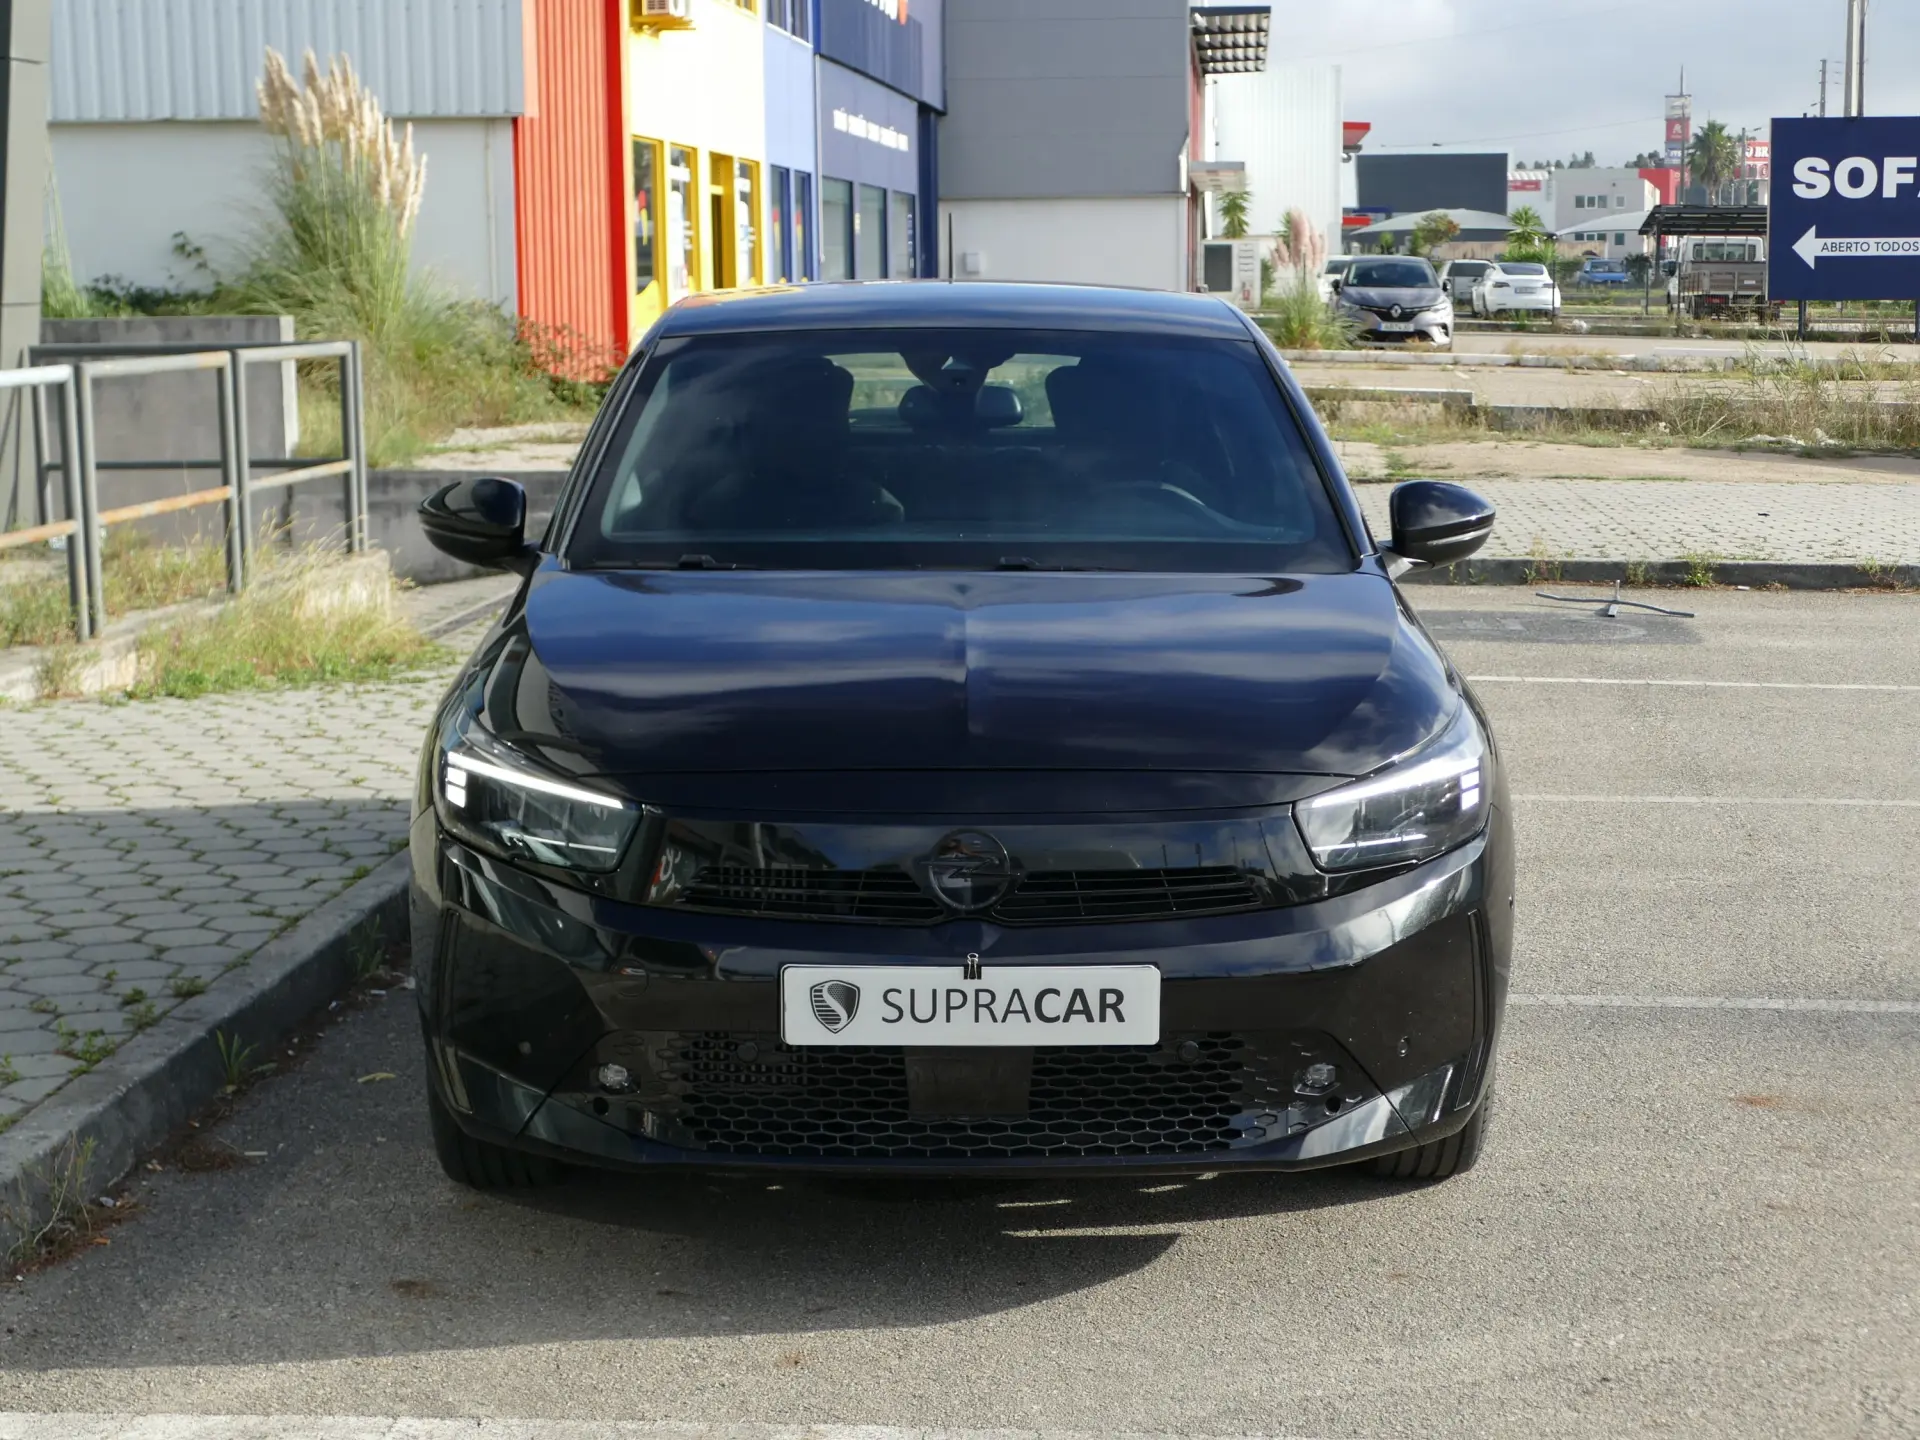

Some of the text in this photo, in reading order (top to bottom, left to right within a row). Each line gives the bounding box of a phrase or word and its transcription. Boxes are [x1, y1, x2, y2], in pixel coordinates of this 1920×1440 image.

[1792, 156, 1920, 199] SOF
[1821, 241, 1919, 253] ABERTO TODOS
[881, 988, 1126, 1023] SUPRACAR
